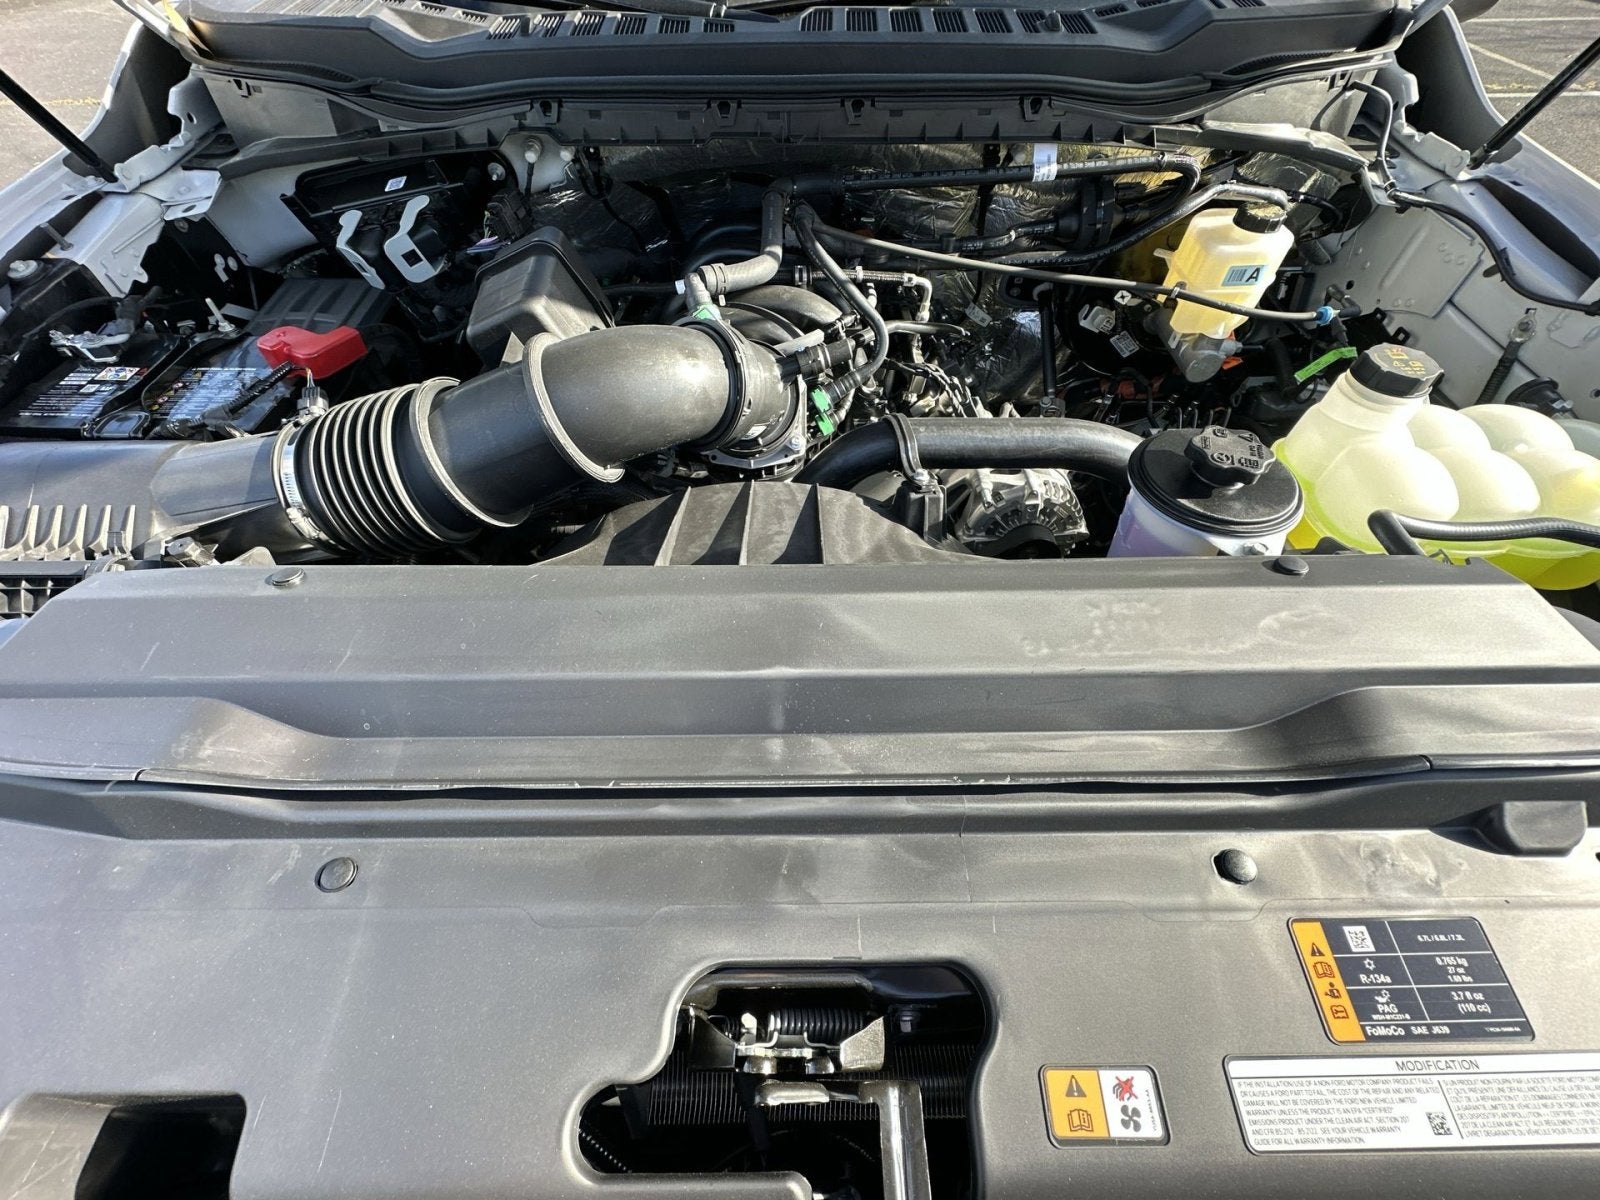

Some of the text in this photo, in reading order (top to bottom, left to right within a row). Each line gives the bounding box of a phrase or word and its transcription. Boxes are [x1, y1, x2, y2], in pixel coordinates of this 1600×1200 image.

[1245, 267, 1261, 283] A
[1455, 956, 1469, 967] kg
[1359, 974, 1392, 984] R-134a
[1450, 990, 1465, 1001] 3.7
[1472, 992, 1486, 1001] oz
[1376, 1003, 1399, 1014] PAG
[1475, 1002, 1492, 1014] cc)
[1365, 1025, 1451, 1037] FoMoCo SAE J639
[1395, 1058, 1480, 1071] MODIFICATION
